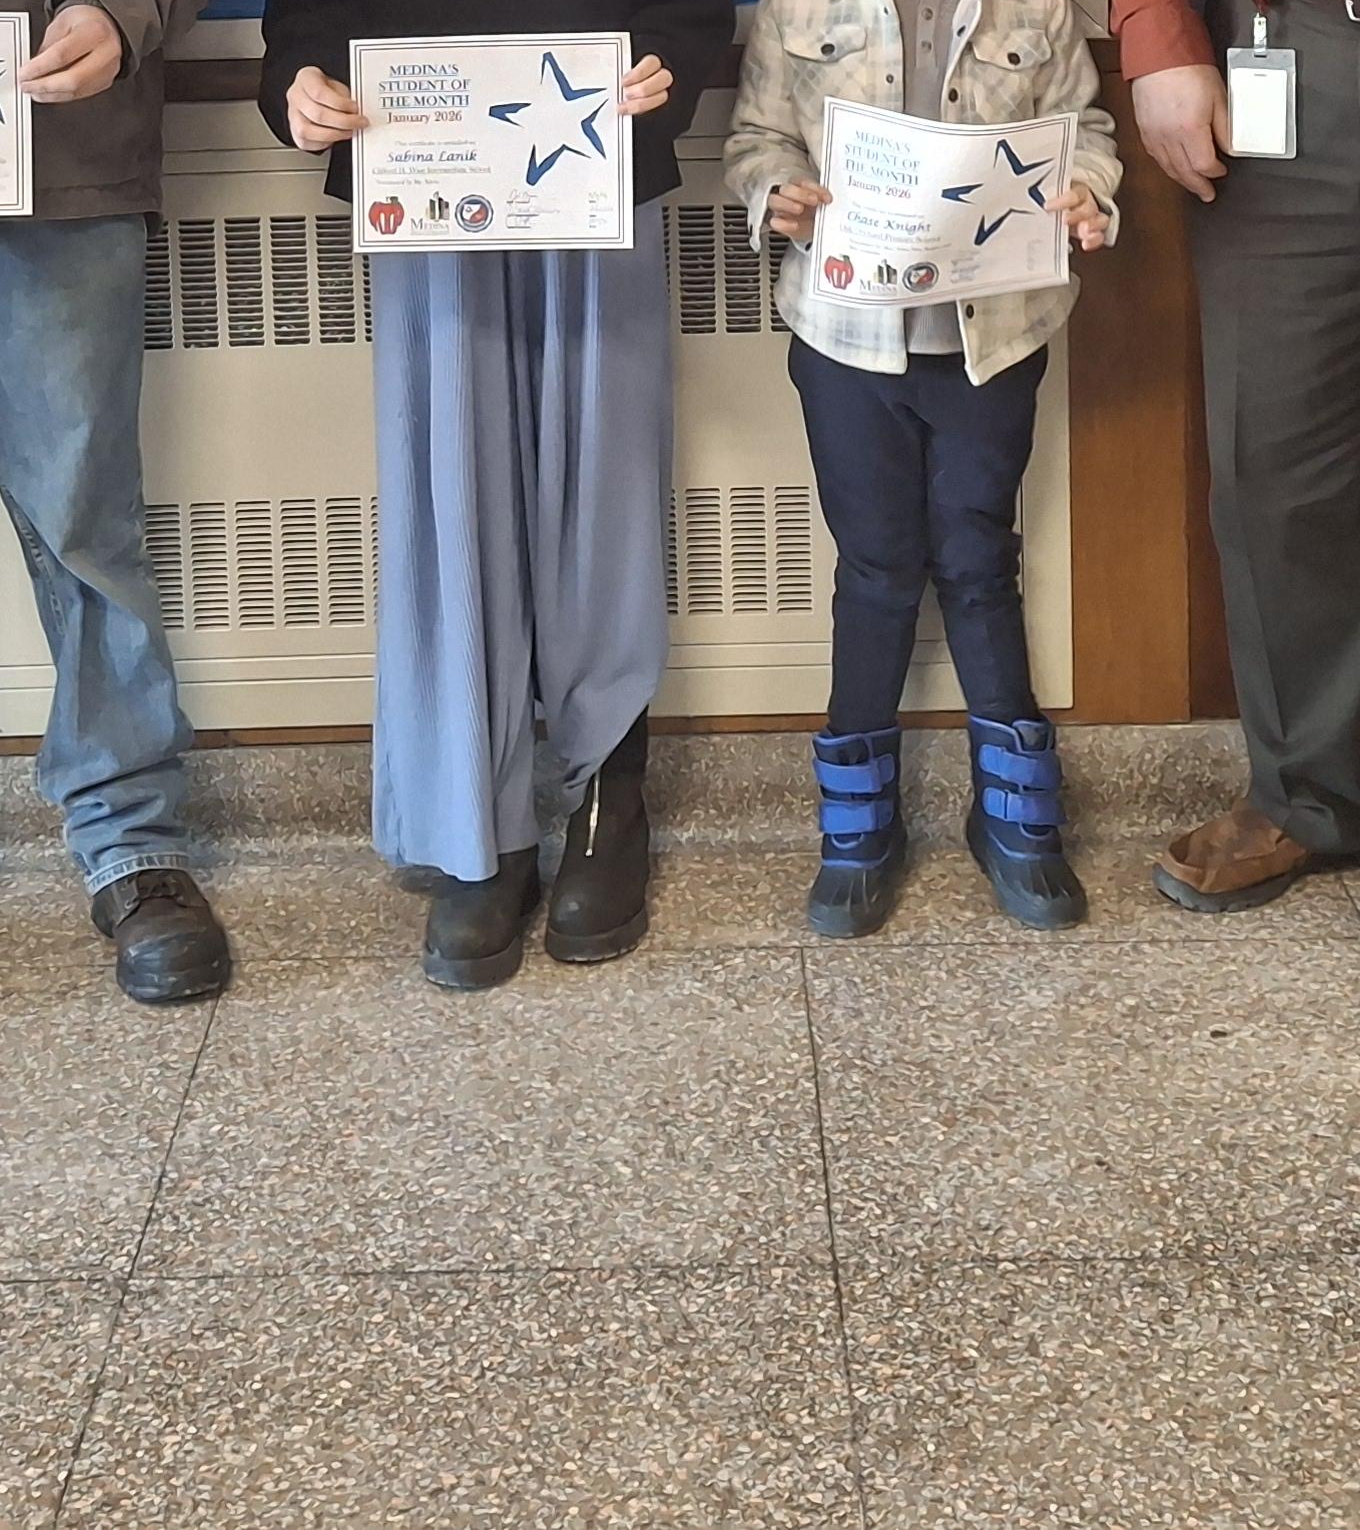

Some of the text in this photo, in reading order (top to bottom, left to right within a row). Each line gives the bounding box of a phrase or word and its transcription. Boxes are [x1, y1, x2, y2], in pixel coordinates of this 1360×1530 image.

[389, 64, 459, 76] MEDINA'S
[379, 79, 471, 91] STUDENT OF
[380, 95, 470, 107] THE MONTH
[387, 110, 462, 124] January 2026
[387, 149, 477, 163] Sabina Lanik
[902, 158, 920, 170] OF
[871, 166, 919, 186] MONTH
[848, 175, 912, 199] January 2026
[884, 220, 931, 236] Knight
